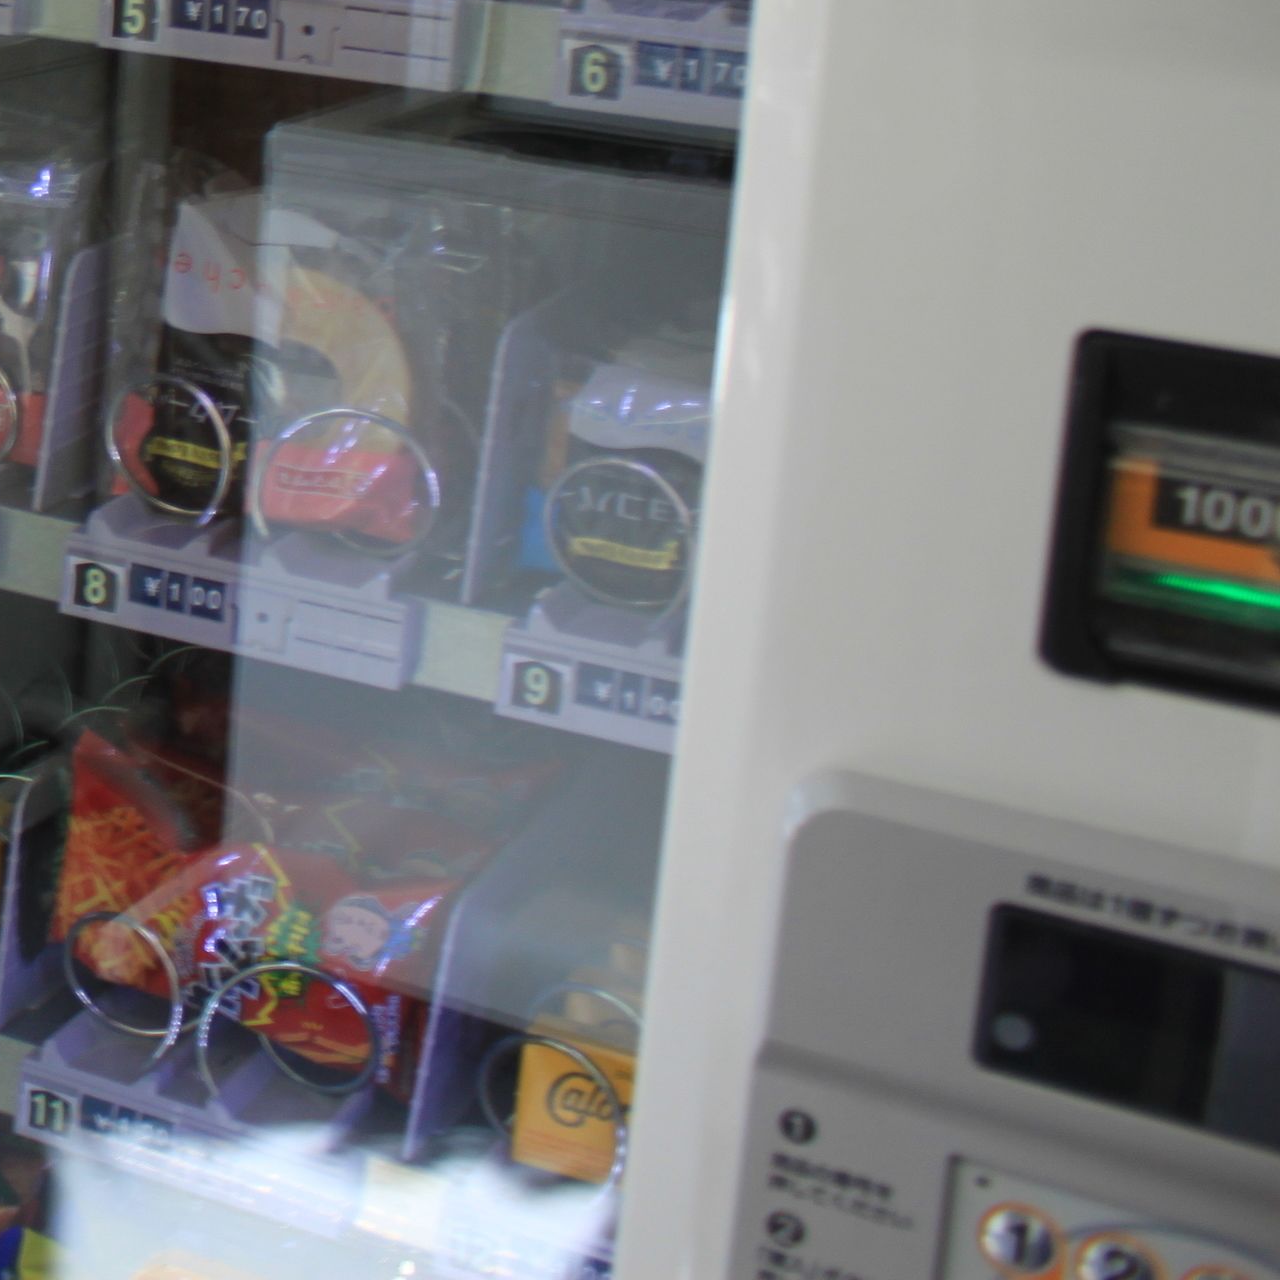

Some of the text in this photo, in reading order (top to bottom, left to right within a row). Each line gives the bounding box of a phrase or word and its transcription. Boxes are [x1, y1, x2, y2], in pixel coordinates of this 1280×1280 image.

[581, 51, 608, 94] 6
[84, 568, 105, 606] 8
[523, 666, 546, 707] 9
[31, 1093, 68, 1129] 11
